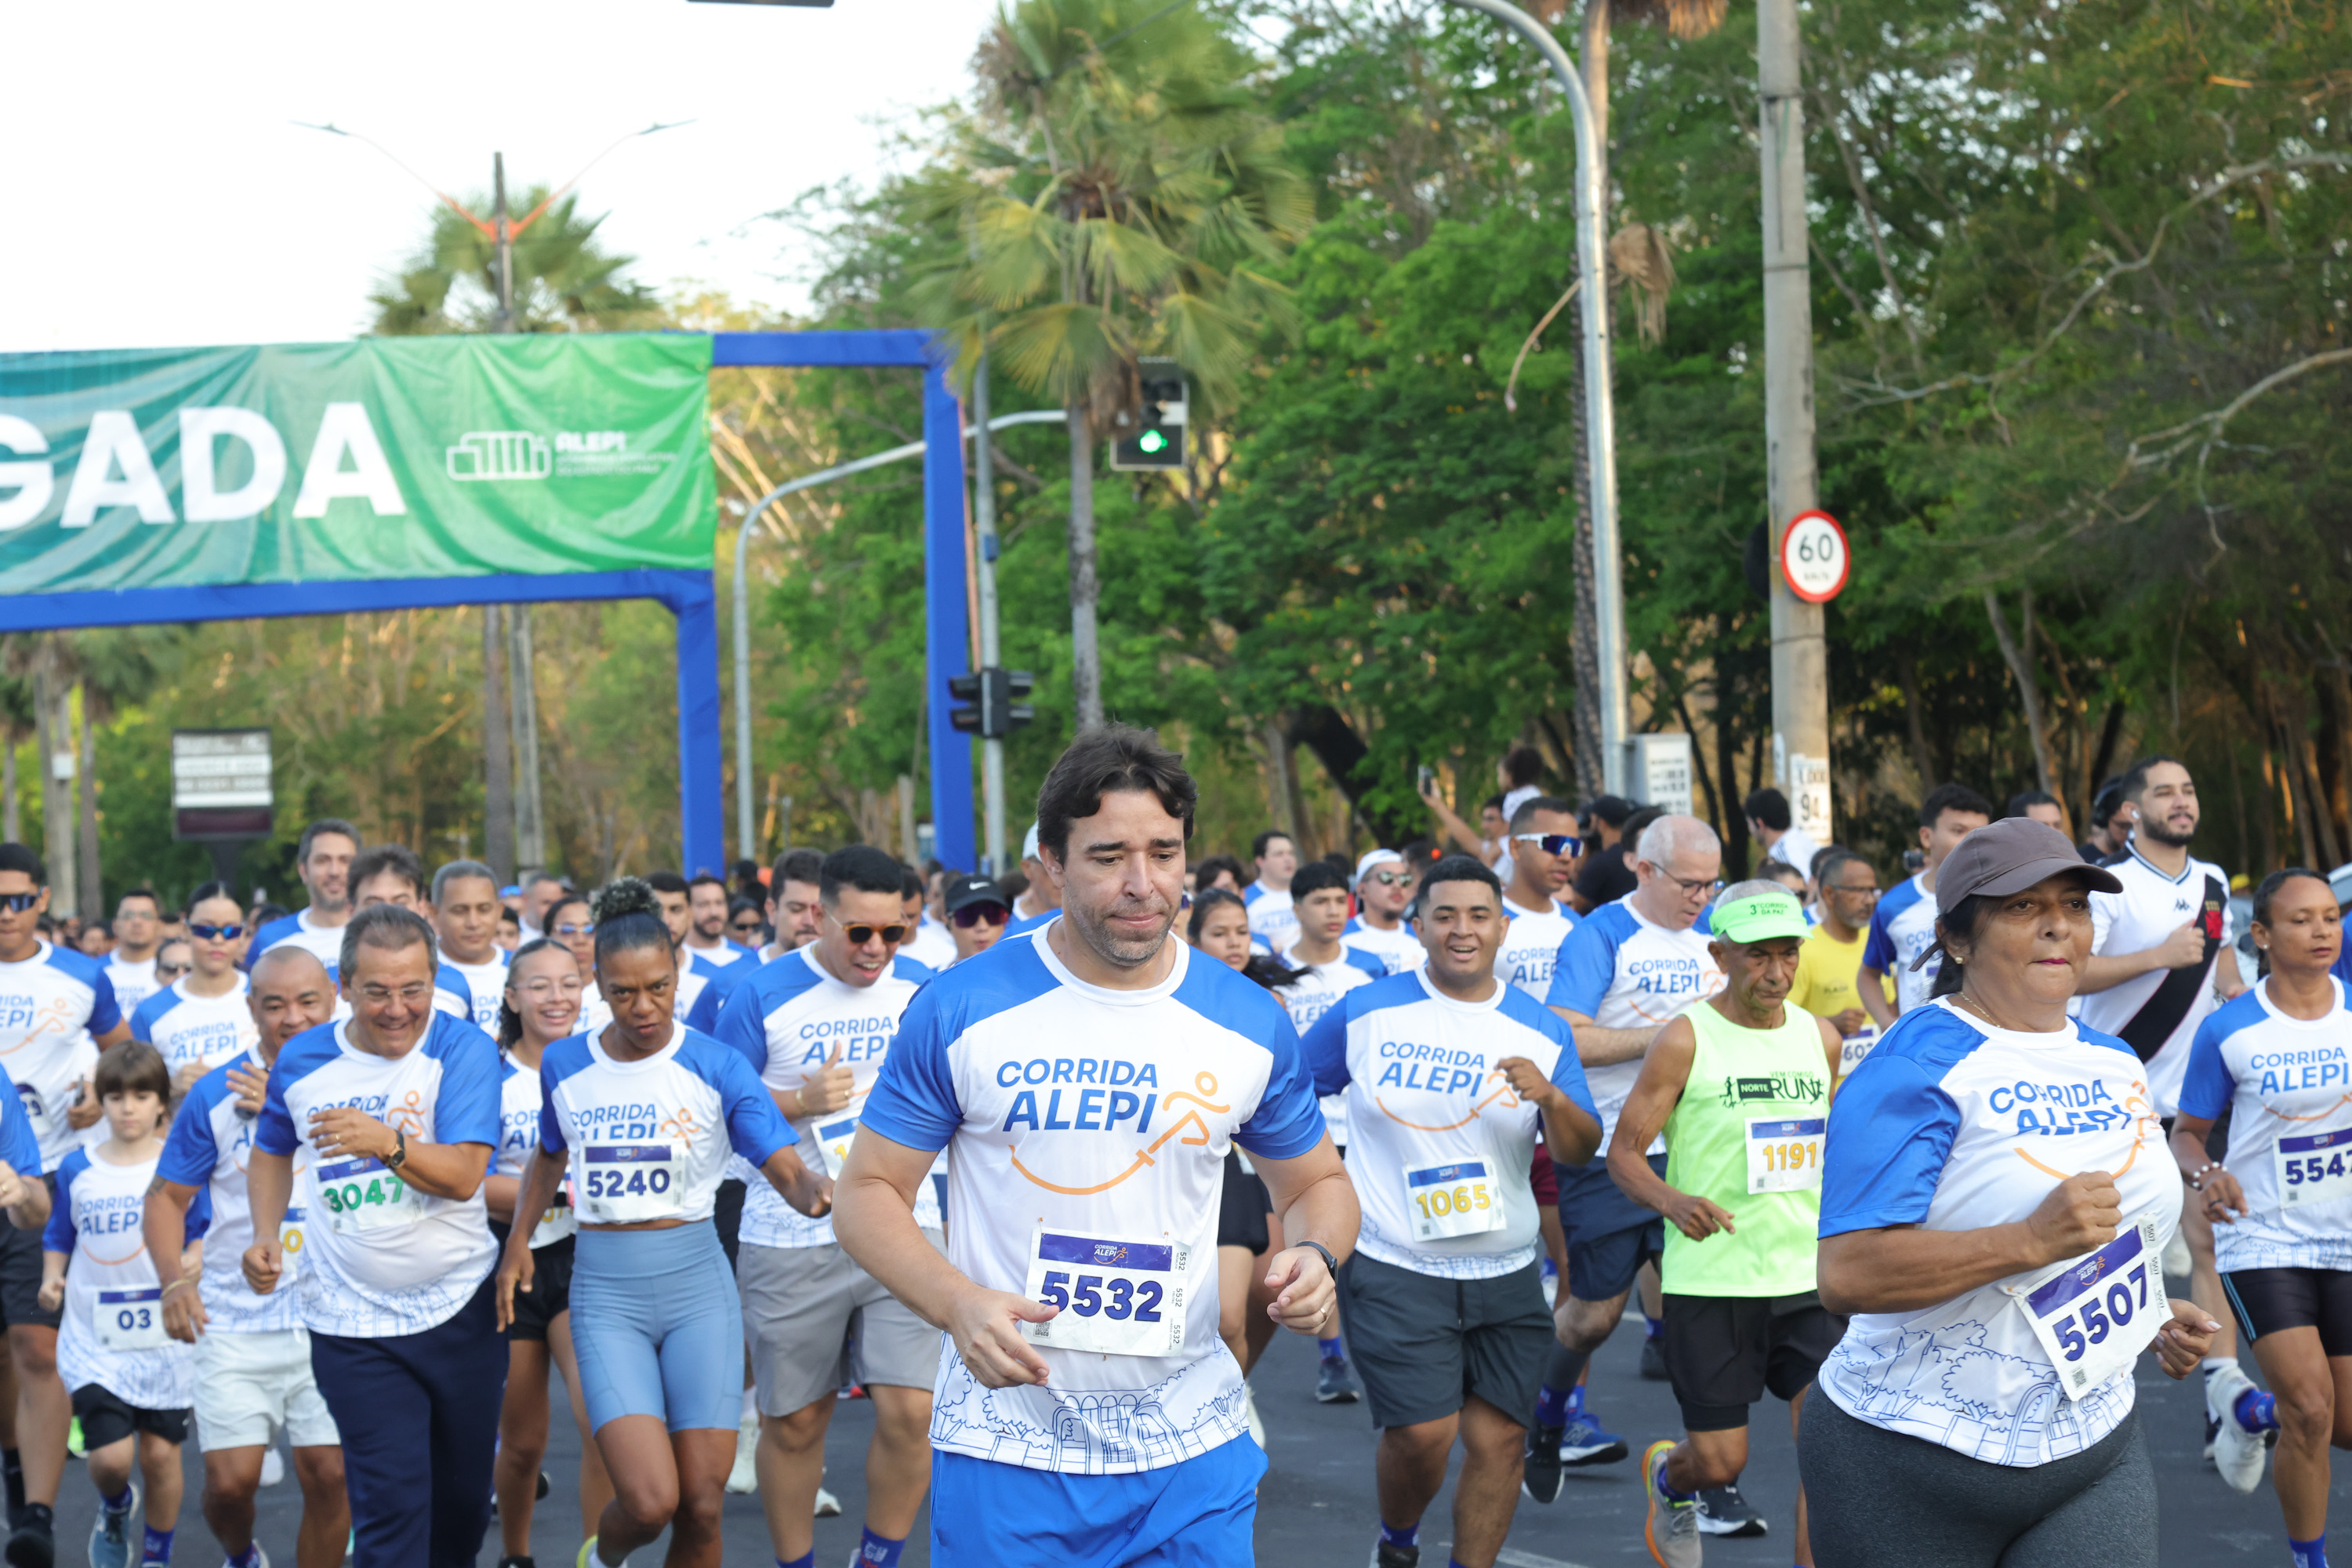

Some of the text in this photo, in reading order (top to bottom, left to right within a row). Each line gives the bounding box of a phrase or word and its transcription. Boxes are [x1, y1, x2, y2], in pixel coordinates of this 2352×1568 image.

[554, 430, 626, 452] ALEPI
[1799, 534, 1833, 561] 60
[1629, 958, 1699, 975] CORRIDA
[1637, 973, 1700, 994] ALEPI
[169, 1022, 235, 1046] CORRIDA
[800, 1017, 894, 1040] CORRIDA
[174, 1035, 238, 1060] ALEPI
[1380, 1041, 1484, 1069] CORRIDA
[2251, 1047, 2347, 1069] CORRIDA
[996, 1058, 1158, 1088] CORRIDA
[1377, 1062, 1484, 1098] ALEPI
[2259, 1062, 2348, 1095] ALEPI
[1740, 1083, 1769, 1093] NORTE
[1990, 1079, 2113, 1114] CORRIDA
[570, 1104, 656, 1127] CORRIDA
[1002, 1089, 1158, 1133] ALEPI
[2016, 1104, 2132, 1136] ALEPI
[1763, 1142, 1817, 1171] 1191
[324, 1175, 405, 1212] 3047
[587, 1168, 670, 1198] 5240
[1416, 1184, 1490, 1218] 1065
[1178, 1251, 1187, 1270] 5532
[2080, 1265, 2097, 1281] ALEPI
[1039, 1270, 1163, 1323] 5532
[118, 1308, 152, 1330] 03
[2052, 1261, 2147, 1362] 5507
